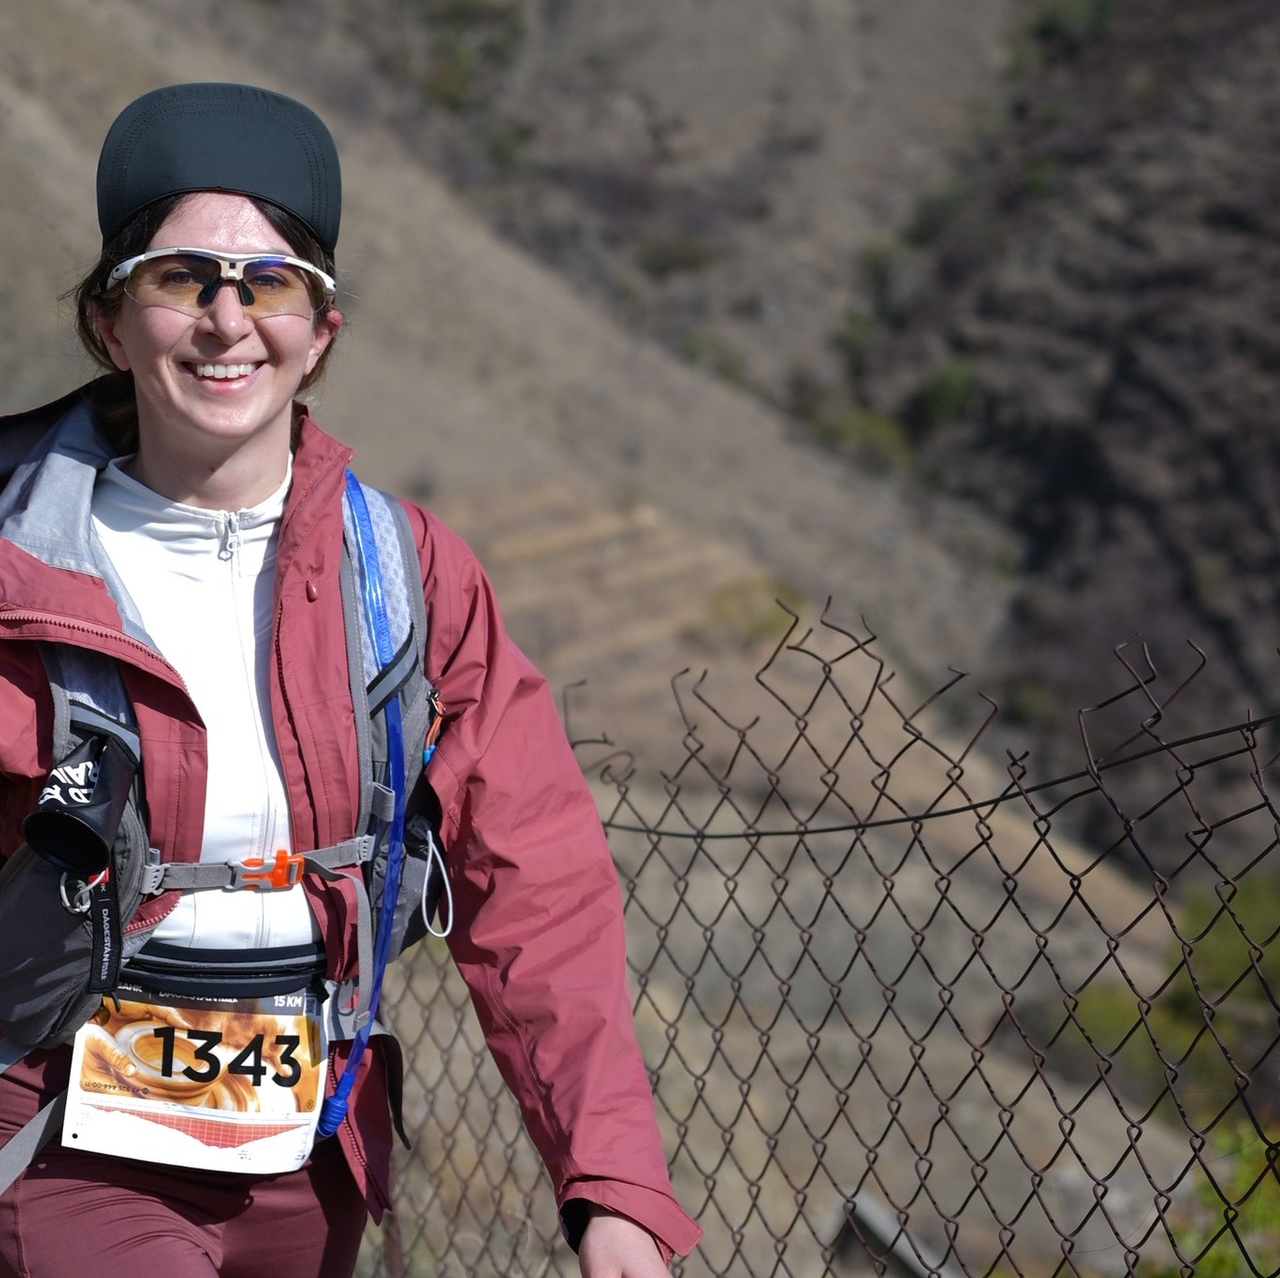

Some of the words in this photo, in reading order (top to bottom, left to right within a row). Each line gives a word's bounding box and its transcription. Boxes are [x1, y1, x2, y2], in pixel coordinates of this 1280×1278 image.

[273, 996, 286, 1007] 15
[286, 996, 302, 1008] KM
[153, 1025, 302, 1088] 1343
